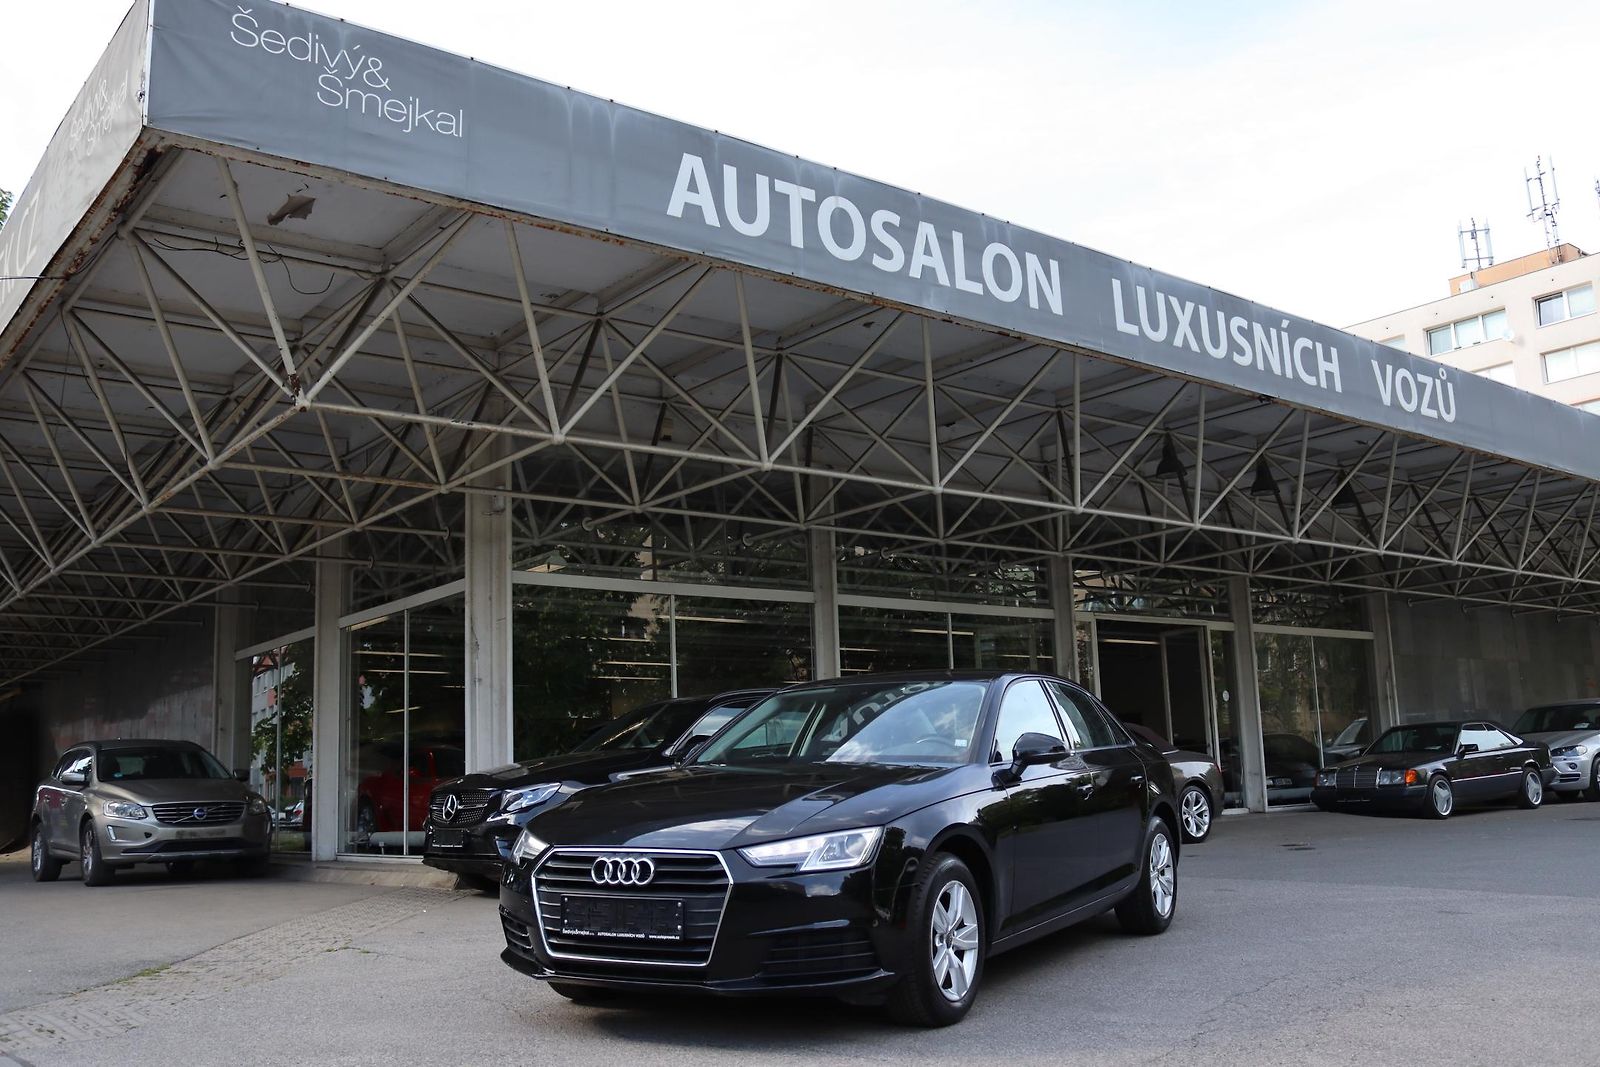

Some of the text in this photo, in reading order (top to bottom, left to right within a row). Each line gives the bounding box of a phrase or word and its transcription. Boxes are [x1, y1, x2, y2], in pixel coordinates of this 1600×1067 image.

[229, 5, 392, 92] Šedivý&
[316, 65, 464, 138] Šmejkal
[666, 152, 1457, 424] AUTOSALON LUXUSNÍCH VOZŮ
